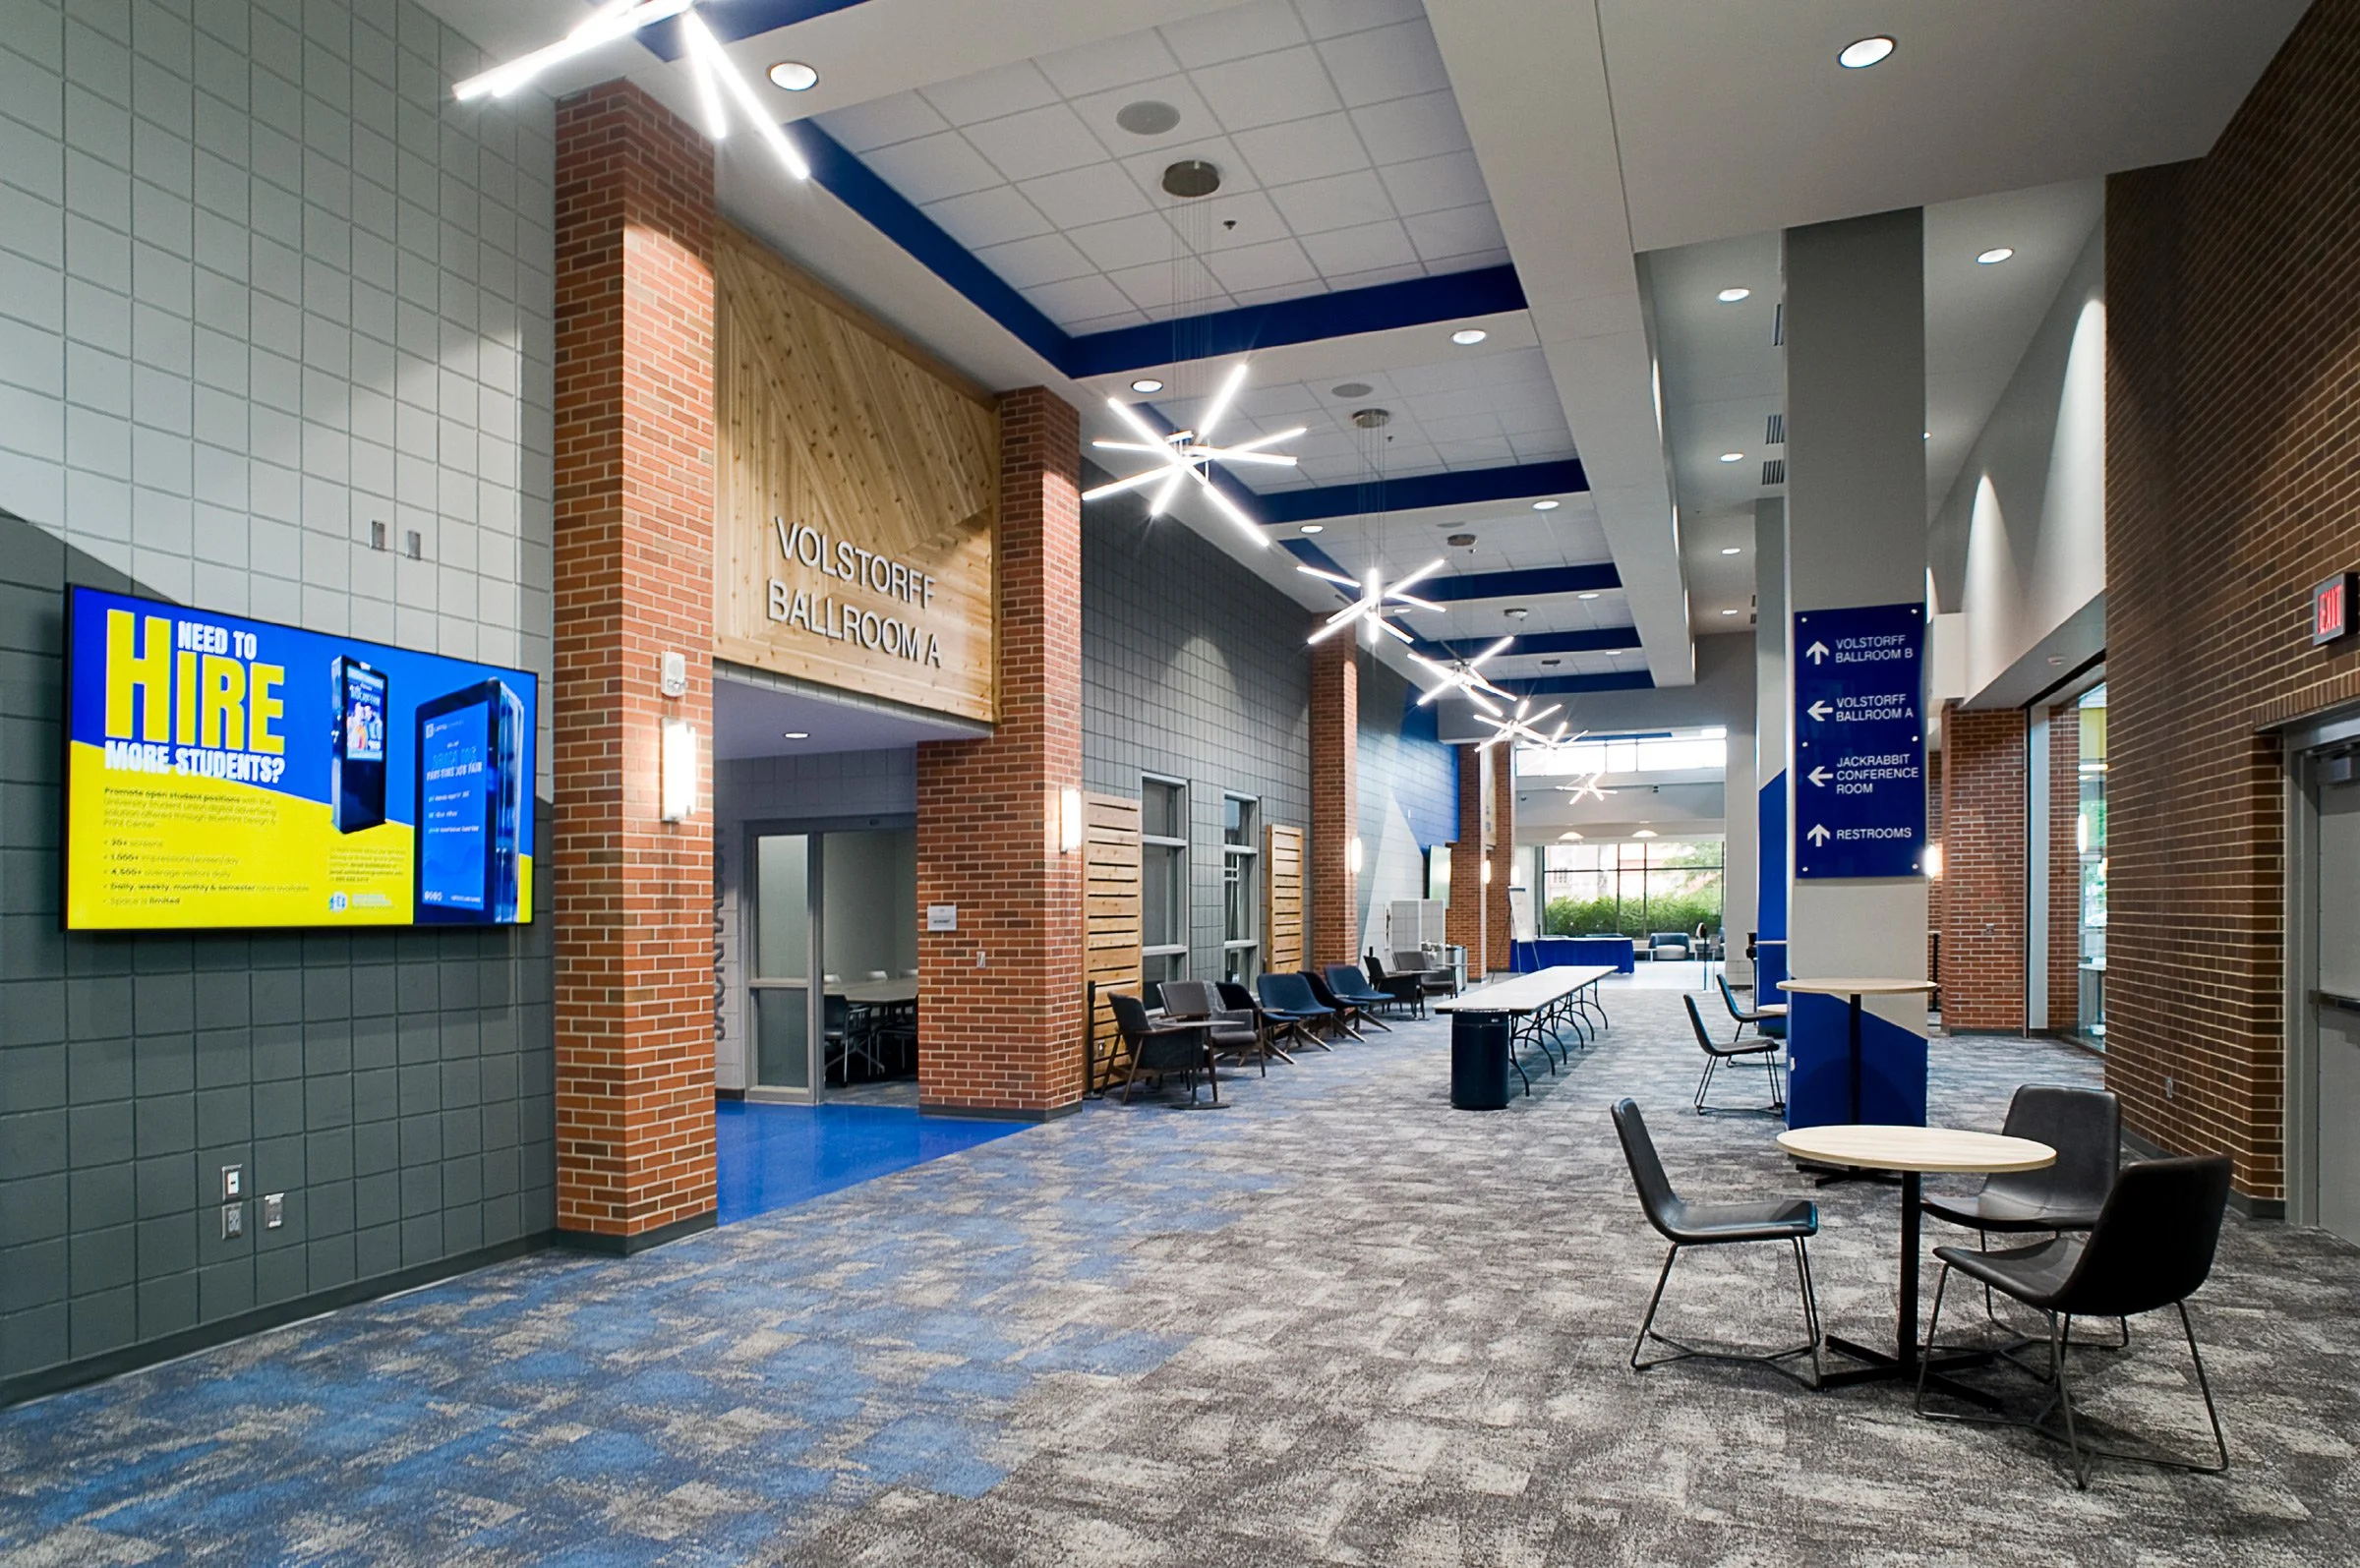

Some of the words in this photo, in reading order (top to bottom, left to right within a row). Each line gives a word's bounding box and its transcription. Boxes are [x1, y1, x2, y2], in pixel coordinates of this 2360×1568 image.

[775, 516, 936, 610] VOLSTORFF
[768, 577, 920, 662] BALLROOM
[925, 634, 941, 668] A
[177, 620, 228, 656] NEED
[233, 630, 257, 661] TO
[1836, 634, 1906, 650] VOLSTORFF
[1835, 649, 1902, 664] BALLROOM
[1905, 648, 1914, 659] B
[105, 609, 285, 755] HIRE
[1836, 694, 1907, 708] VOLSTORFF
[1836, 708, 1902, 722] BALLROOM
[1904, 708, 1914, 719] A
[104, 740, 169, 774] MORE
[175, 748, 286, 784] STUDENTS?
[1836, 754, 1911, 768] JACKRABBIT
[1836, 767, 1919, 781] CONFERENCE
[1836, 784, 1873, 794] ROOM
[169, 792, 202, 801] student
[204, 794, 240, 804] positions
[1836, 828, 1912, 841] RESTROOMS
